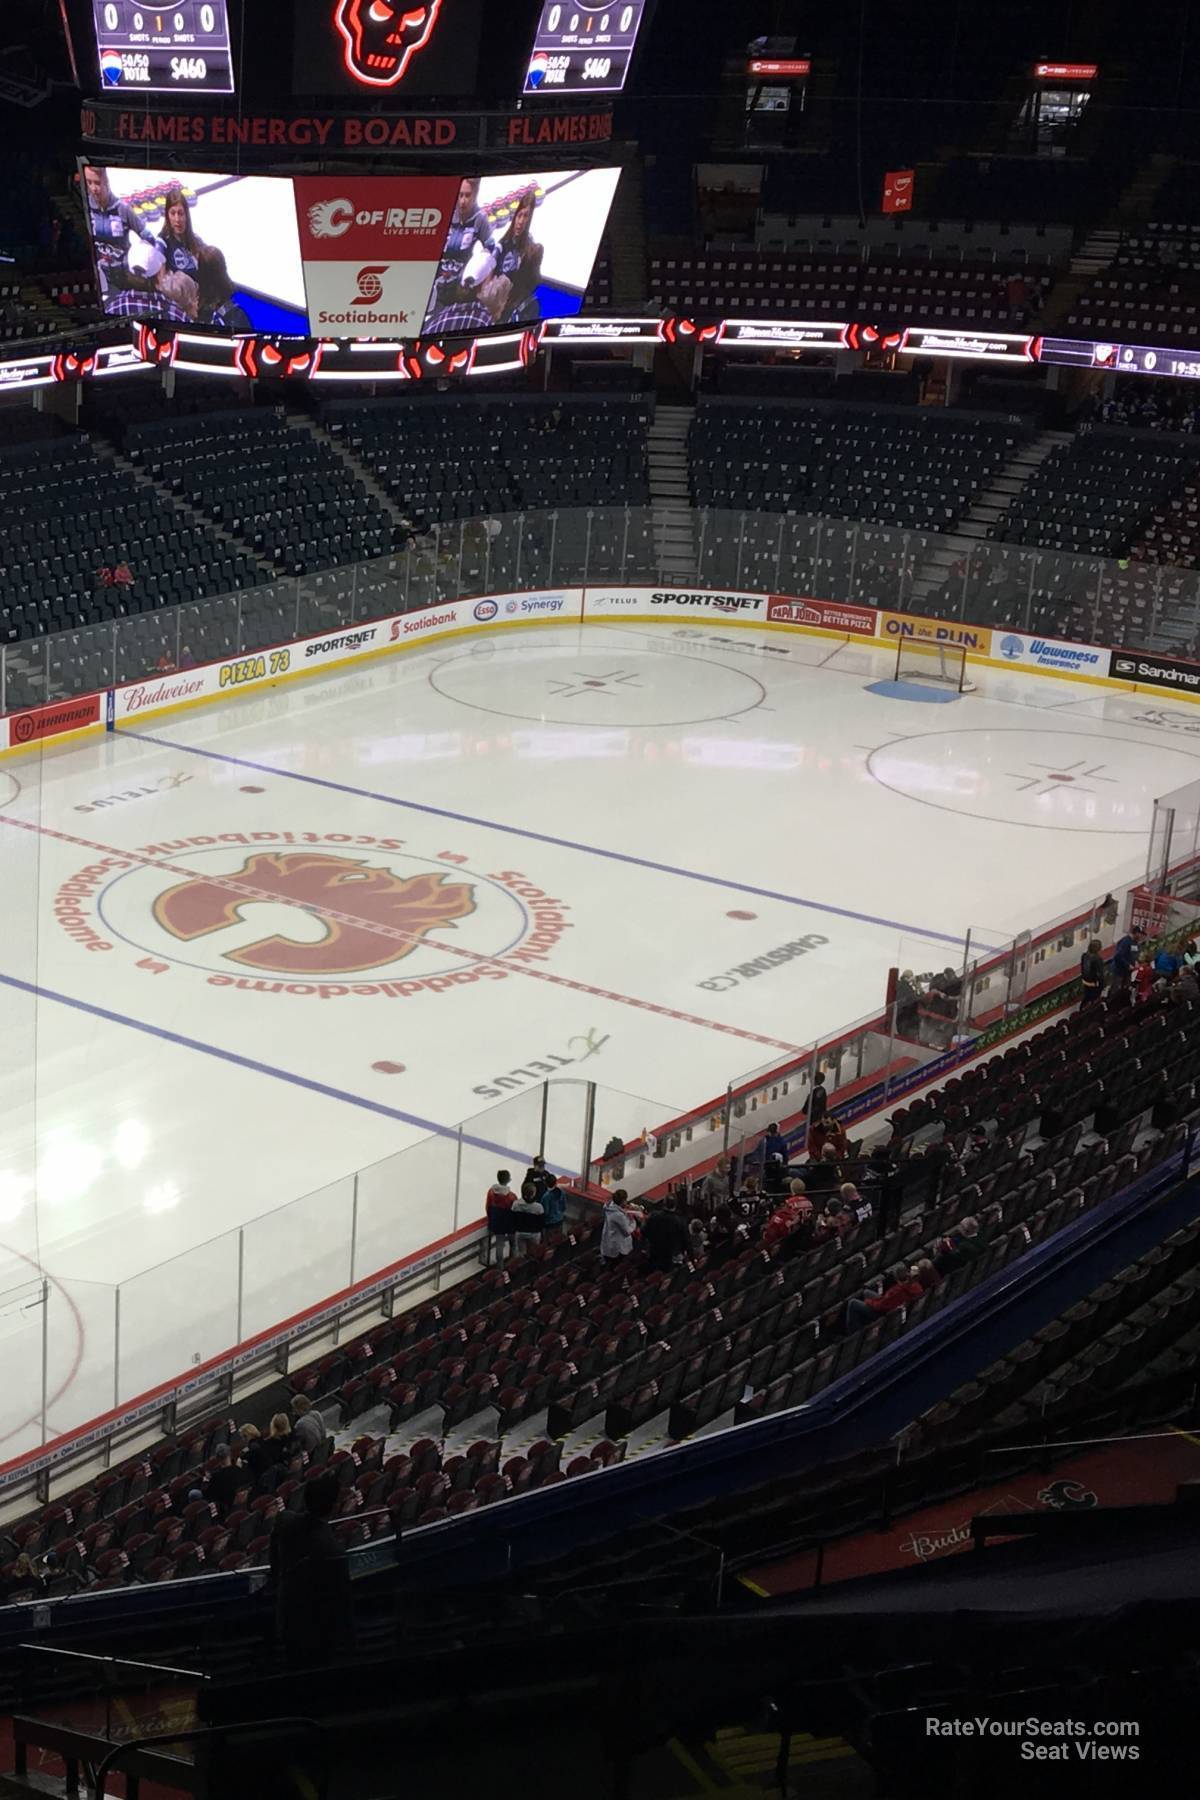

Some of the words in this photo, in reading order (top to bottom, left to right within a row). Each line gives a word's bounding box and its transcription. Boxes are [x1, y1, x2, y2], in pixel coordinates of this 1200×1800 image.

[104, 3, 118, 30] 0
[134, 13, 143, 31] 0
[174, 13, 184, 31] 0
[201, 4, 214, 32] 0
[548, 4, 561, 32] 0
[570, 14, 579, 31] 0
[600, 14, 609, 31] 0
[620, 6, 633, 32] 0
[122, 54, 149, 67] 50/50
[170, 57, 206, 80] $460
[118, 111, 204, 142] FLAMES
[210, 115, 335, 145] ENERGY
[343, 117, 456, 145] BOARD
[507, 113, 587, 145] FLAMES
[356, 211, 384, 225] OF
[385, 208, 442, 228] RED
[318, 310, 408, 324] Scotiabank
[1145, 352, 1156, 369] 0
[477, 606, 495, 616] Esso
[521, 599, 564, 613] Synergy
[610, 597, 638, 605] TELUS
[650, 593, 764, 610] SPORTSNET
[773, 605, 793, 620] PAPA
[403, 610, 457, 634] Scotiabank
[823, 615, 849, 626] BETTER
[886, 620, 914, 636] ON
[305, 628, 377, 657] SPORTSNET
[1029, 639, 1100, 664] Wawanesa
[219, 659, 265, 687] PIZZA
[269, 649, 290, 673] 73
[1037, 654, 1081, 670] Insurance
[124, 679, 204, 712] Budweiser
[73, 787, 159, 815] TELUS
[136, 831, 407, 864] Scotiabank
[53, 856, 132, 953] Saddledome
[487, 869, 575, 964] Scotiabank
[696, 933, 829, 993] CARSTAR.ca
[206, 965, 509, 999] Saddledome
[473, 1054, 575, 1099] TELUS
